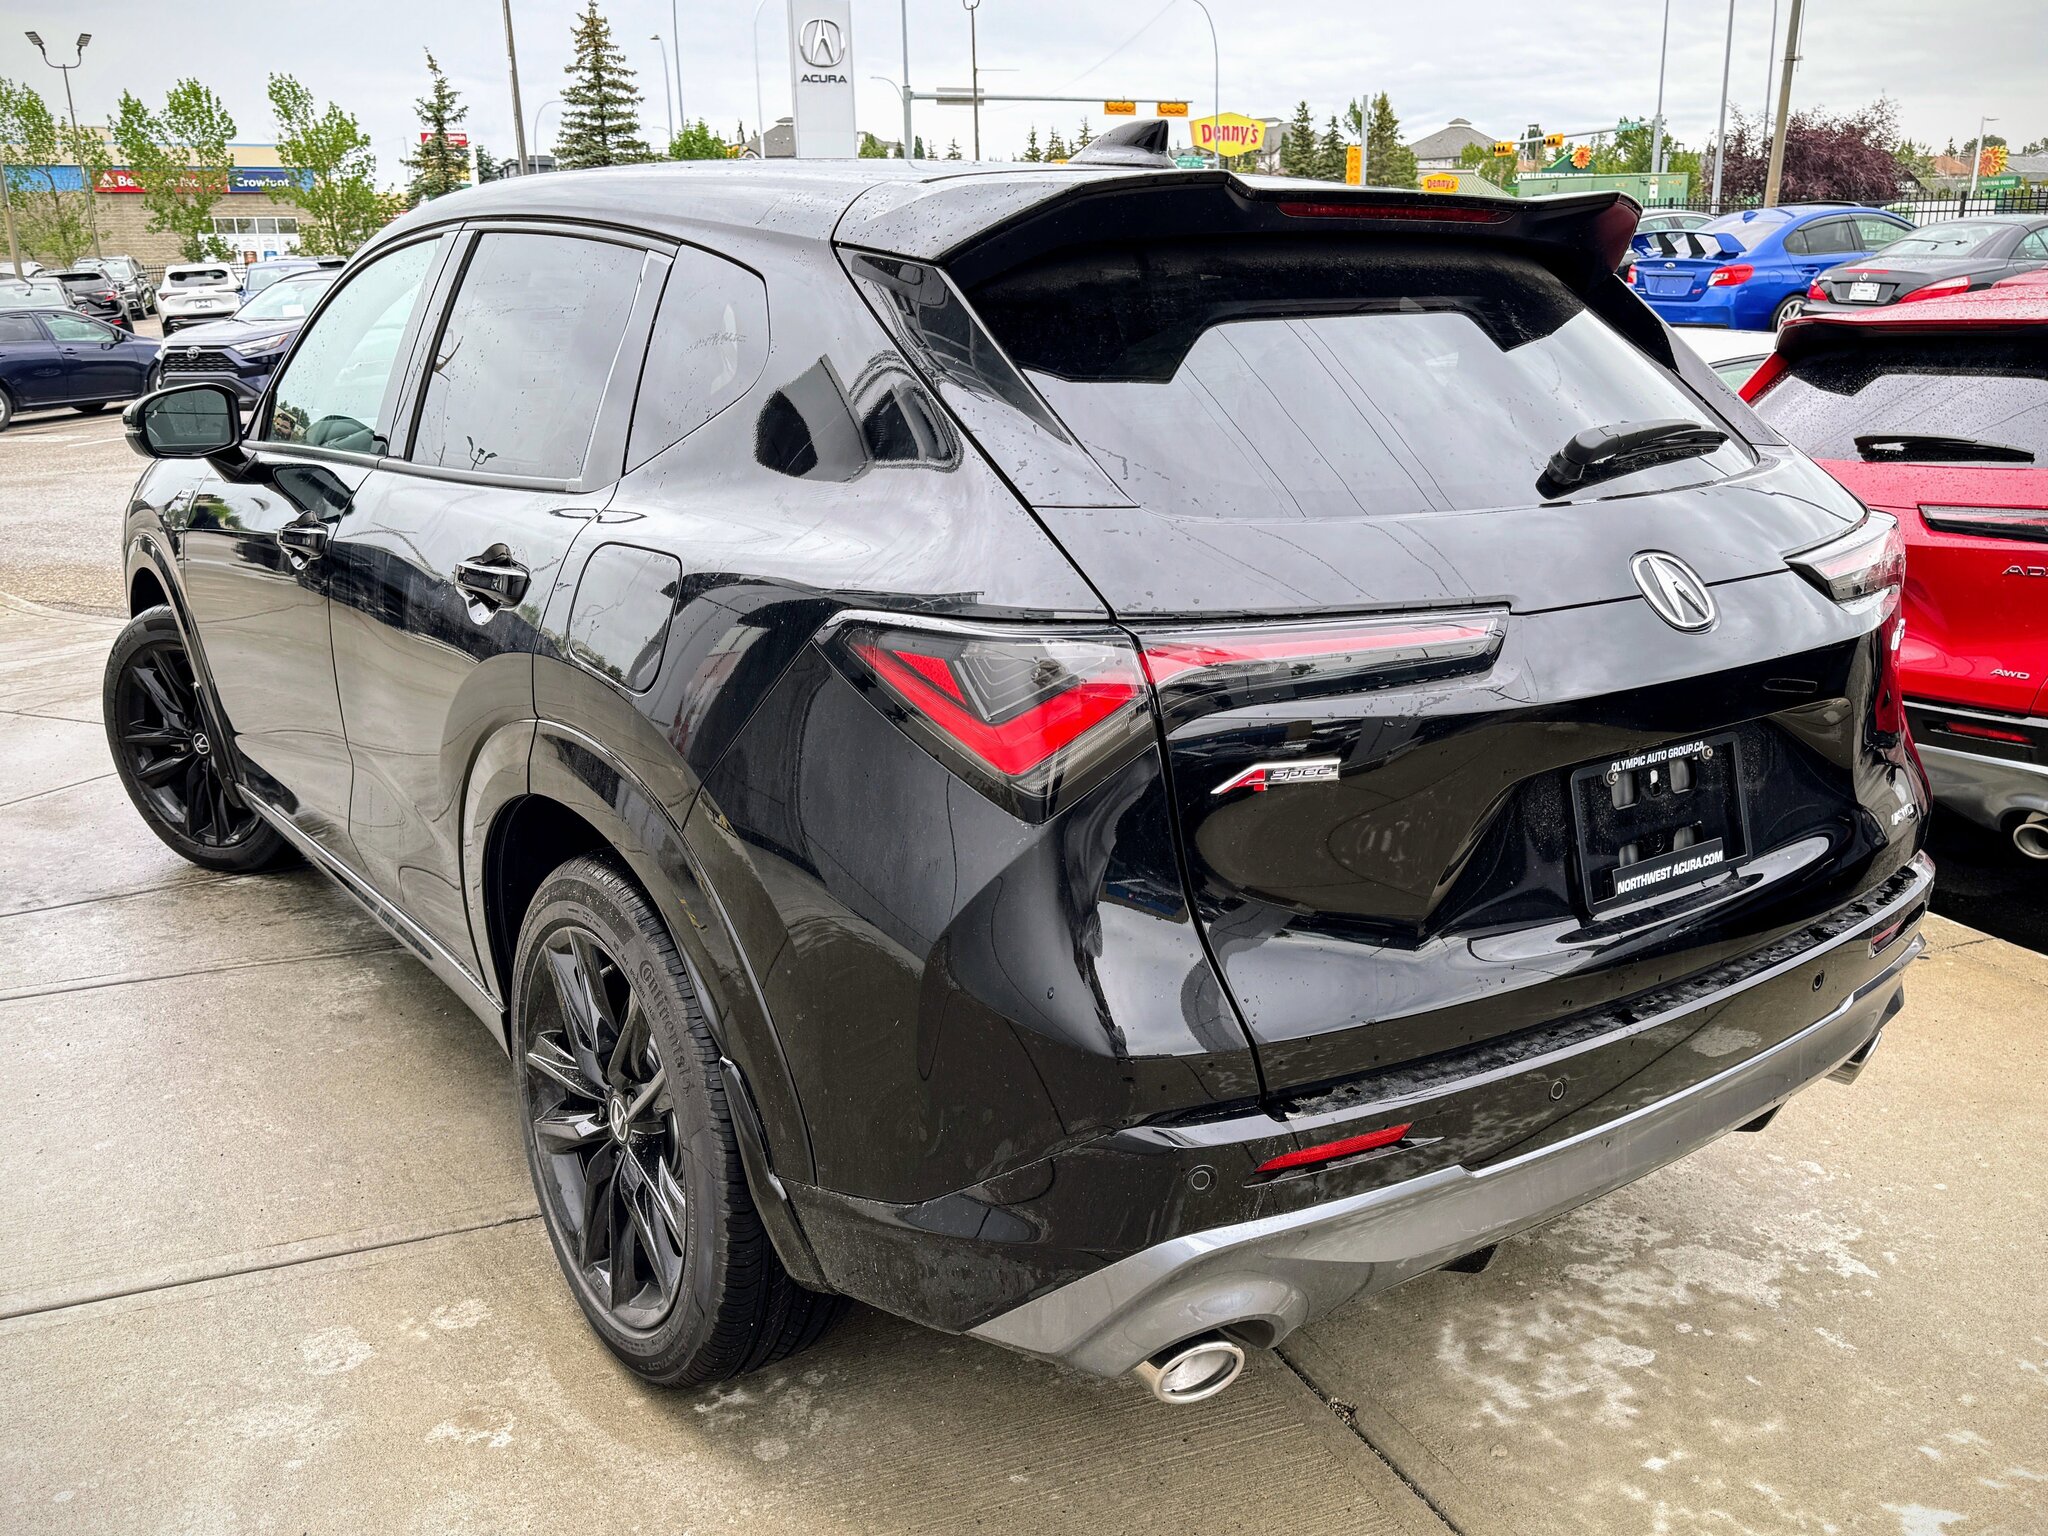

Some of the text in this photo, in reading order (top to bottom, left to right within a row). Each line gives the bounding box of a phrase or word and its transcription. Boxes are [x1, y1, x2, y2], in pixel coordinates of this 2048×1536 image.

[801, 74, 847, 83] ACURA
[1201, 123, 1259, 145] Denny's
[1427, 178, 1456, 189] Denny's
[2001, 564, 2048, 576] AD
[1990, 668, 2030, 680] AWD
[1611, 740, 1704, 773] OLYMPIC AUTO GROUP.CA
[1617, 850, 1723, 894] NORTHWEST ACURA.COM
